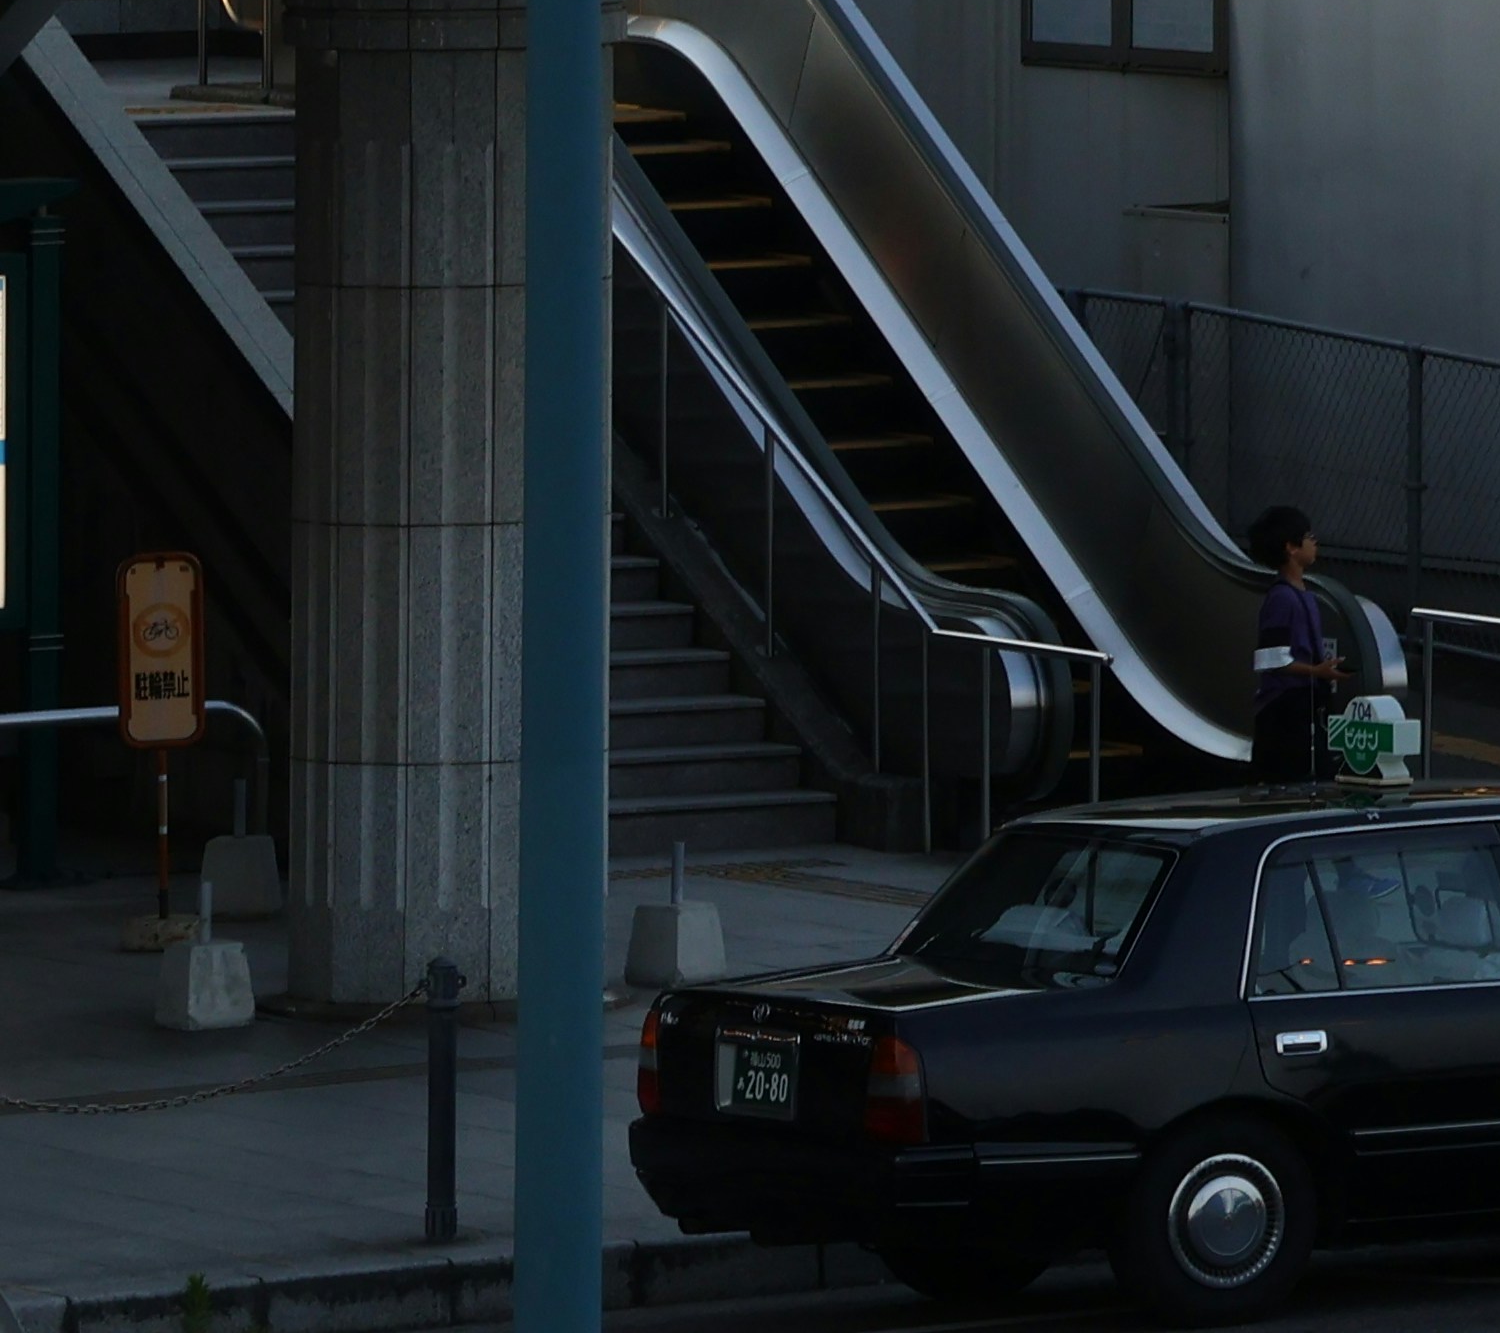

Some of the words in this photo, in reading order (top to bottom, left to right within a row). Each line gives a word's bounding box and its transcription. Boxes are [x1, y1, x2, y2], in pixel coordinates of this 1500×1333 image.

[135, 670, 190, 700] 駐輪禁止
[1352, 702, 1372, 720] 704
[1345, 727, 1379, 750] ビサン
[745, 1070, 788, 1103] 20-80
